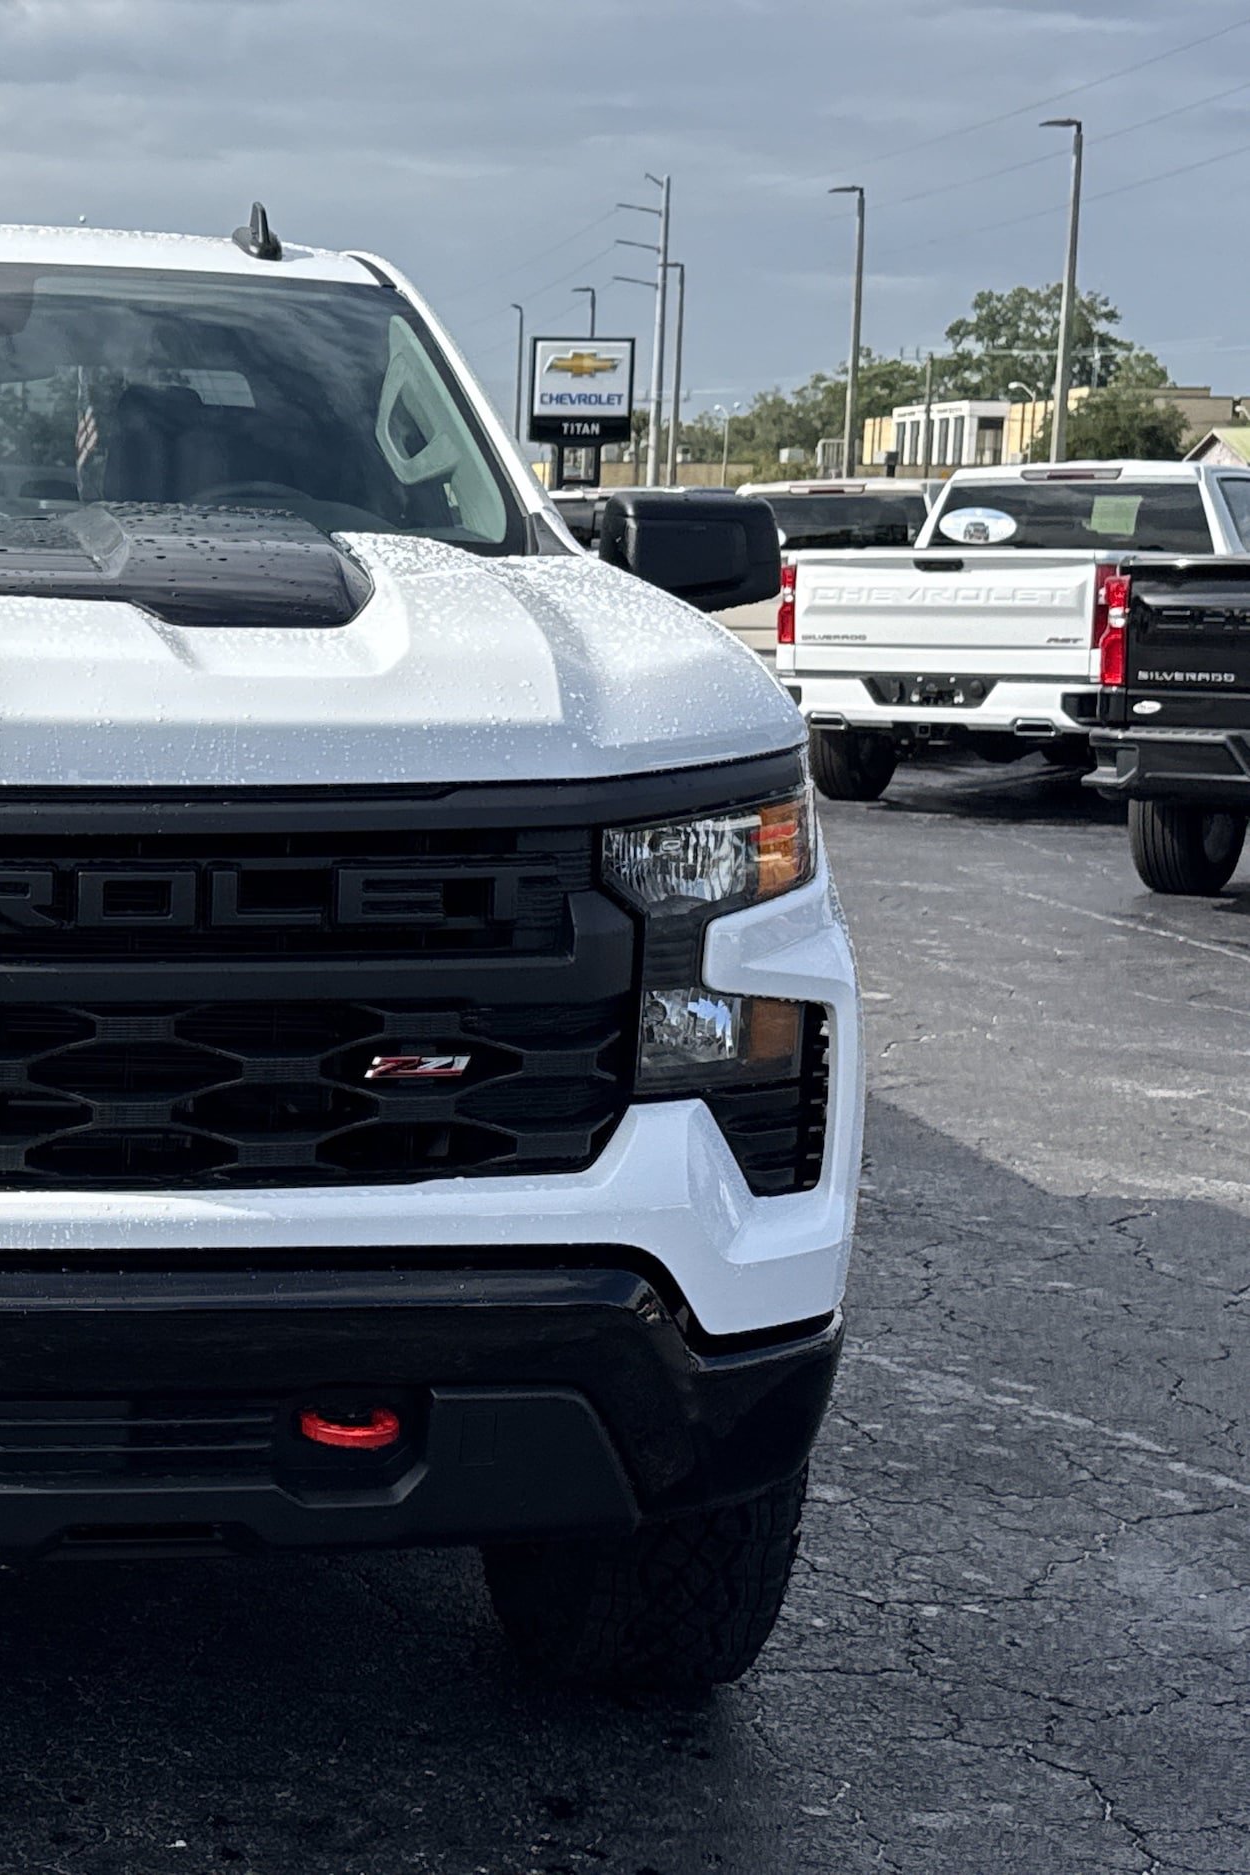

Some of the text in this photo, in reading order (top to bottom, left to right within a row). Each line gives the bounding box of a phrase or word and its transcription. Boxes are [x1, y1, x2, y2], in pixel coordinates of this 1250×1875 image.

[540, 393, 623, 406] CHEVROLET
[562, 423, 600, 435] TITAN
[811, 586, 1071, 607] CHEVROLET
[801, 633, 868, 641] SILVERADO
[1138, 670, 1235, 682] SILVERADO
[364, 1055, 471, 1078] Z71
